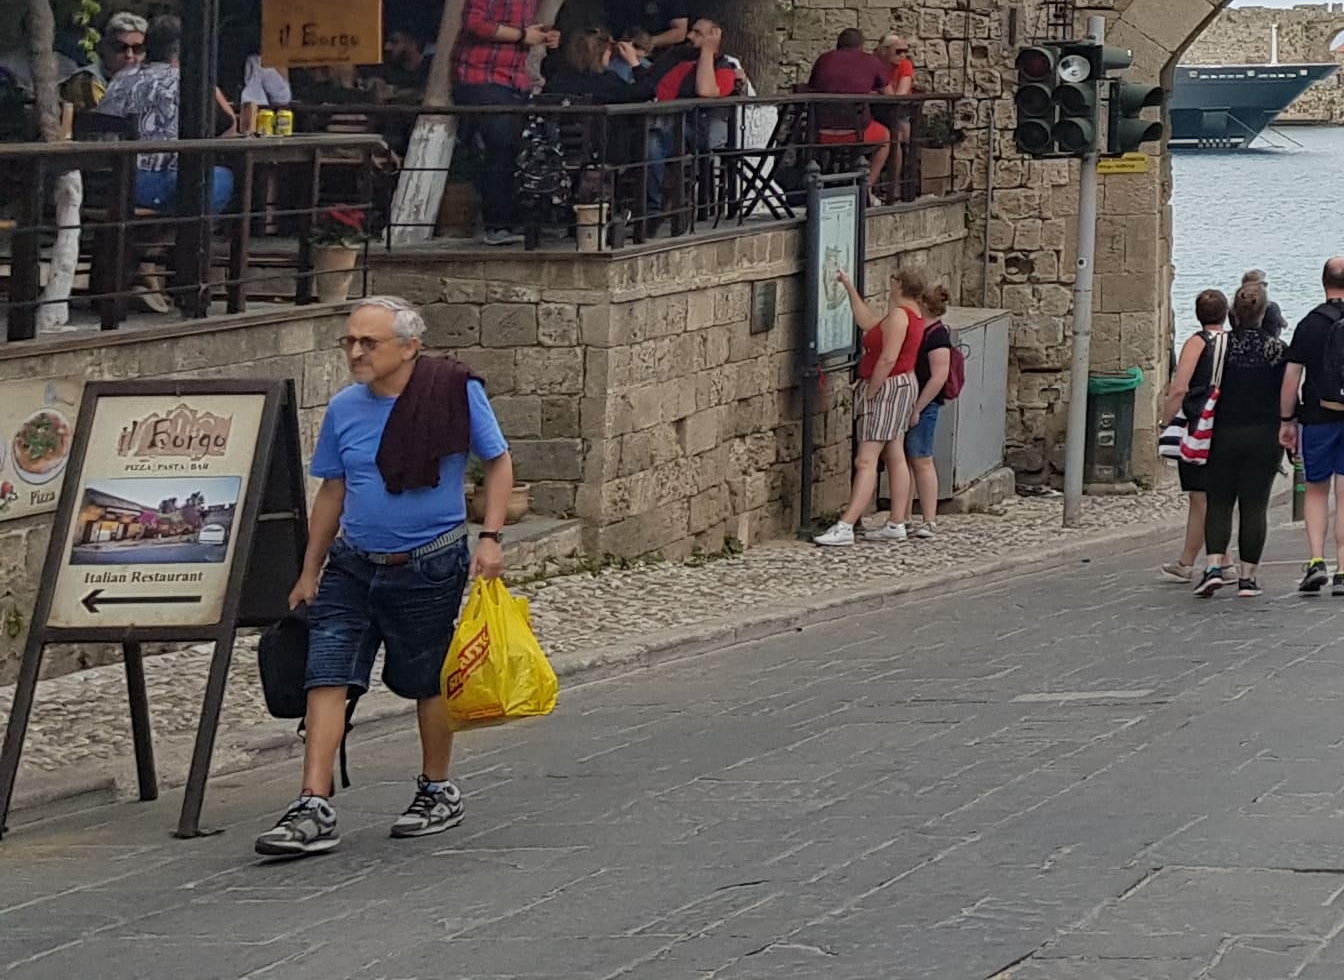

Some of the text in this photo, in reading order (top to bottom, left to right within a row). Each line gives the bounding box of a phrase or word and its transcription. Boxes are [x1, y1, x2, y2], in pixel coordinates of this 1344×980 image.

[118, 418, 226, 461] il Borgo
[30, 490, 55, 505] Pizza
[84, 571, 203, 583] Italian Restaurant
